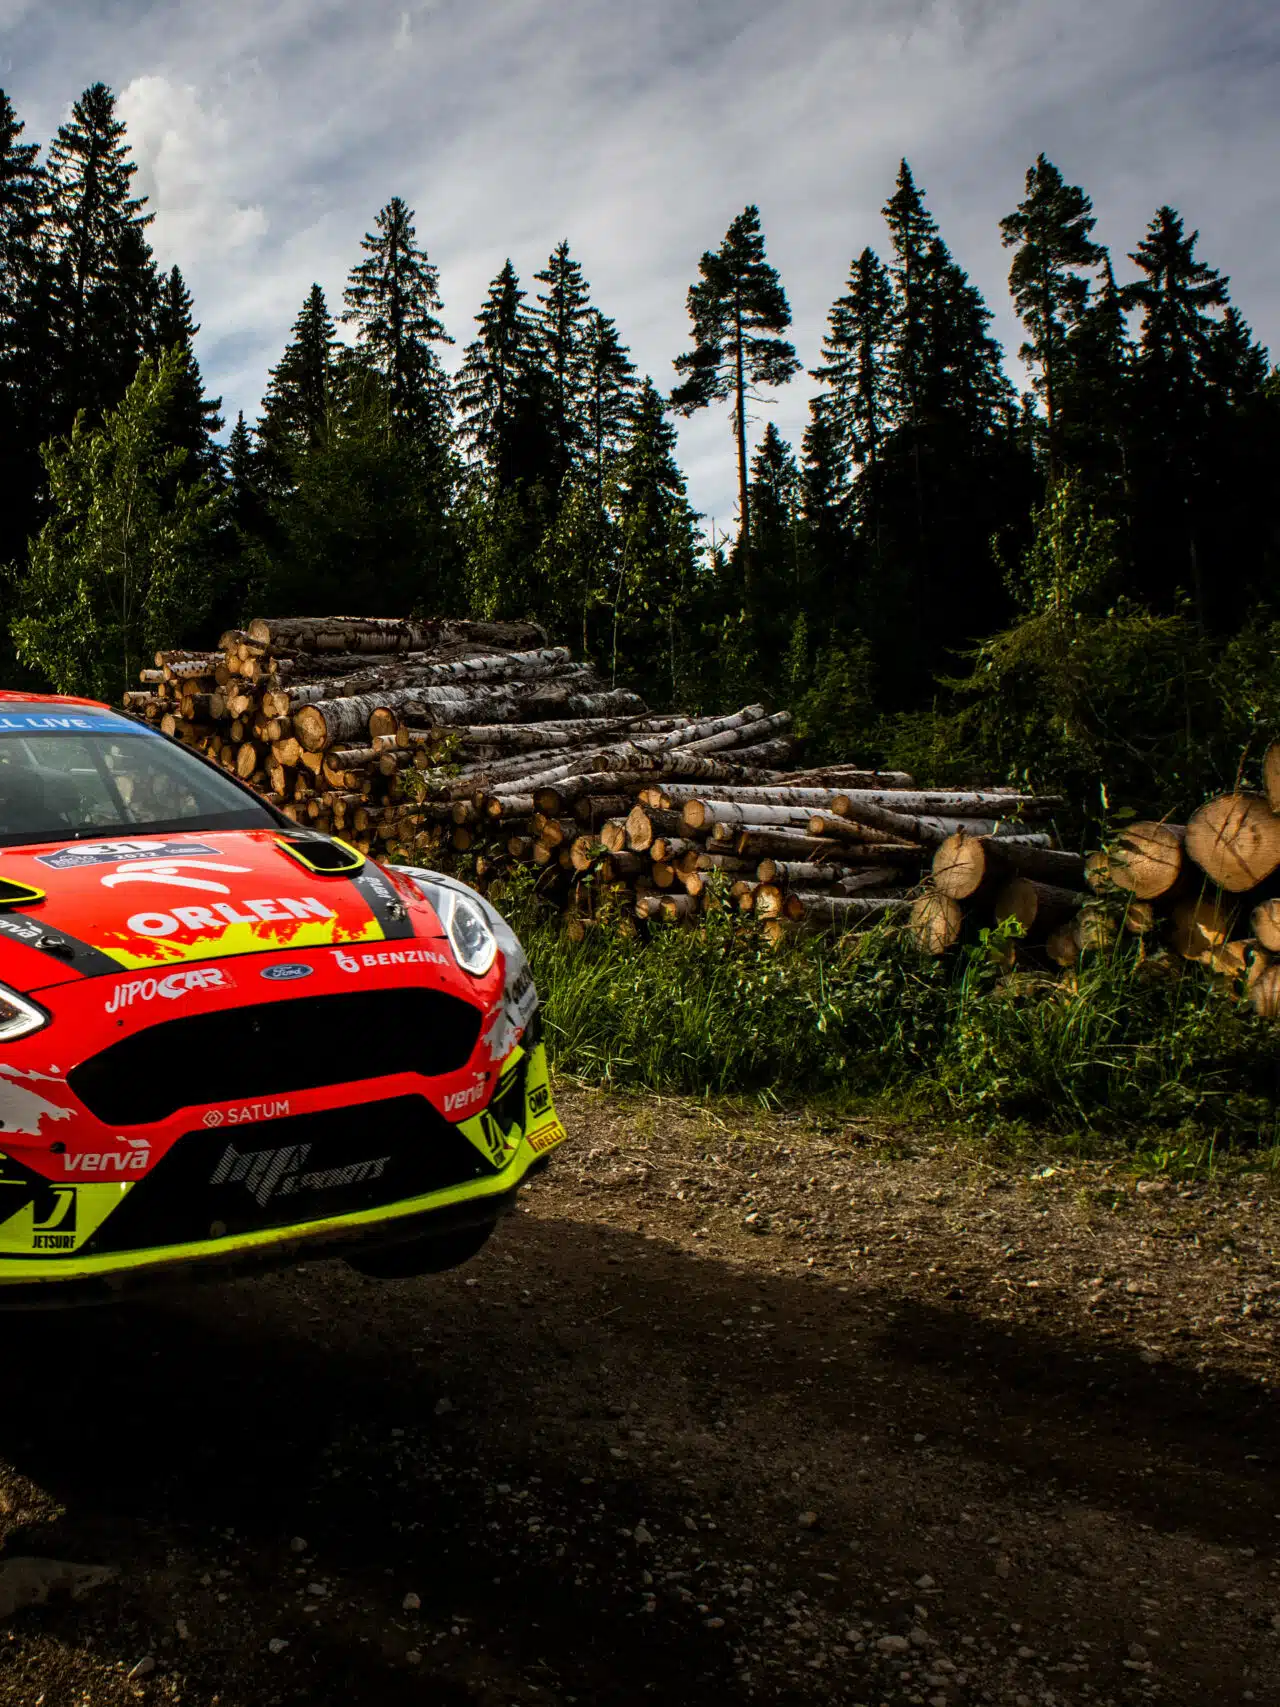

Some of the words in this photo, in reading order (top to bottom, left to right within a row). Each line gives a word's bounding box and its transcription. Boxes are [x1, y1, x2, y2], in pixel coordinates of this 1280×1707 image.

[25, 717, 93, 729] LIVE
[90, 843, 142, 854] 31
[113, 852, 160, 860] 2022
[127, 897, 337, 937] ORLEN
[361, 950, 451, 967] BENZINA
[272, 966, 301, 977] Ford
[105, 967, 226, 1013] JIPOCAR
[443, 1082, 486, 1112] verva
[528, 1088, 549, 1113] OMP
[227, 1100, 290, 1123] SATUM
[526, 1121, 565, 1153] PIRELLI
[63, 1150, 150, 1171] verva
[32, 1235, 76, 1249] JETSURF
